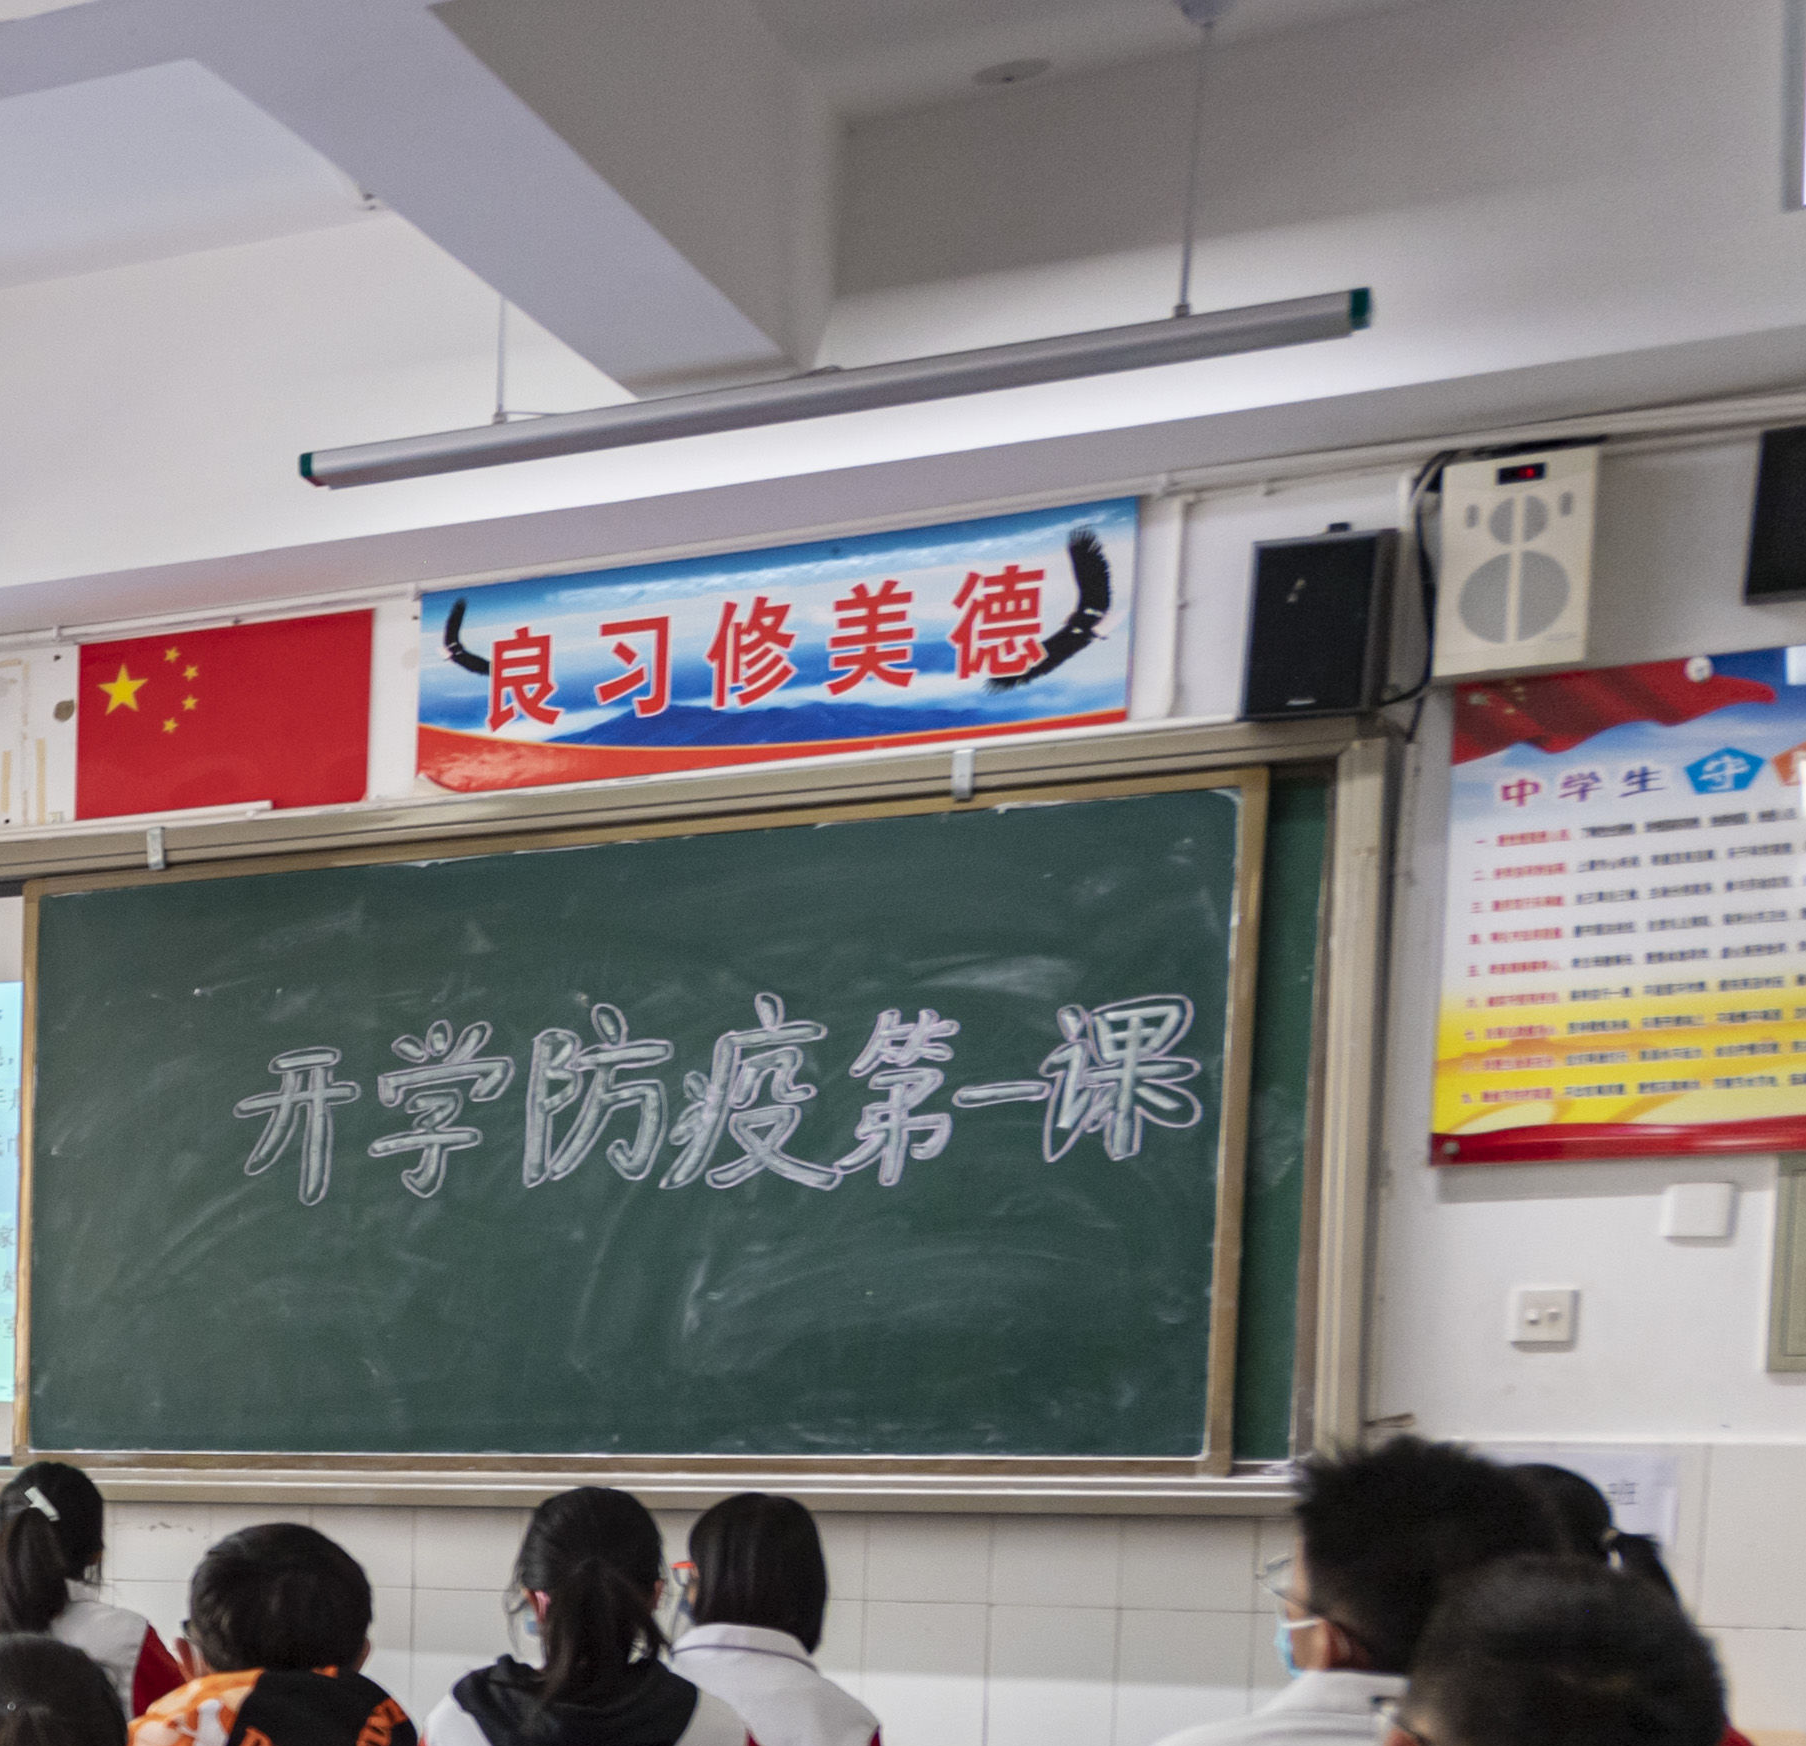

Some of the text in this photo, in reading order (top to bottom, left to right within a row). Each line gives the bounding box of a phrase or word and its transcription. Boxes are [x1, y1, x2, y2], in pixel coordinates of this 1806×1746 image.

[486, 564, 1048, 733] 良习修美德
[1500, 755, 1802, 807] 中学生守
[233, 991, 1201, 1206] 开学防疫第一课
